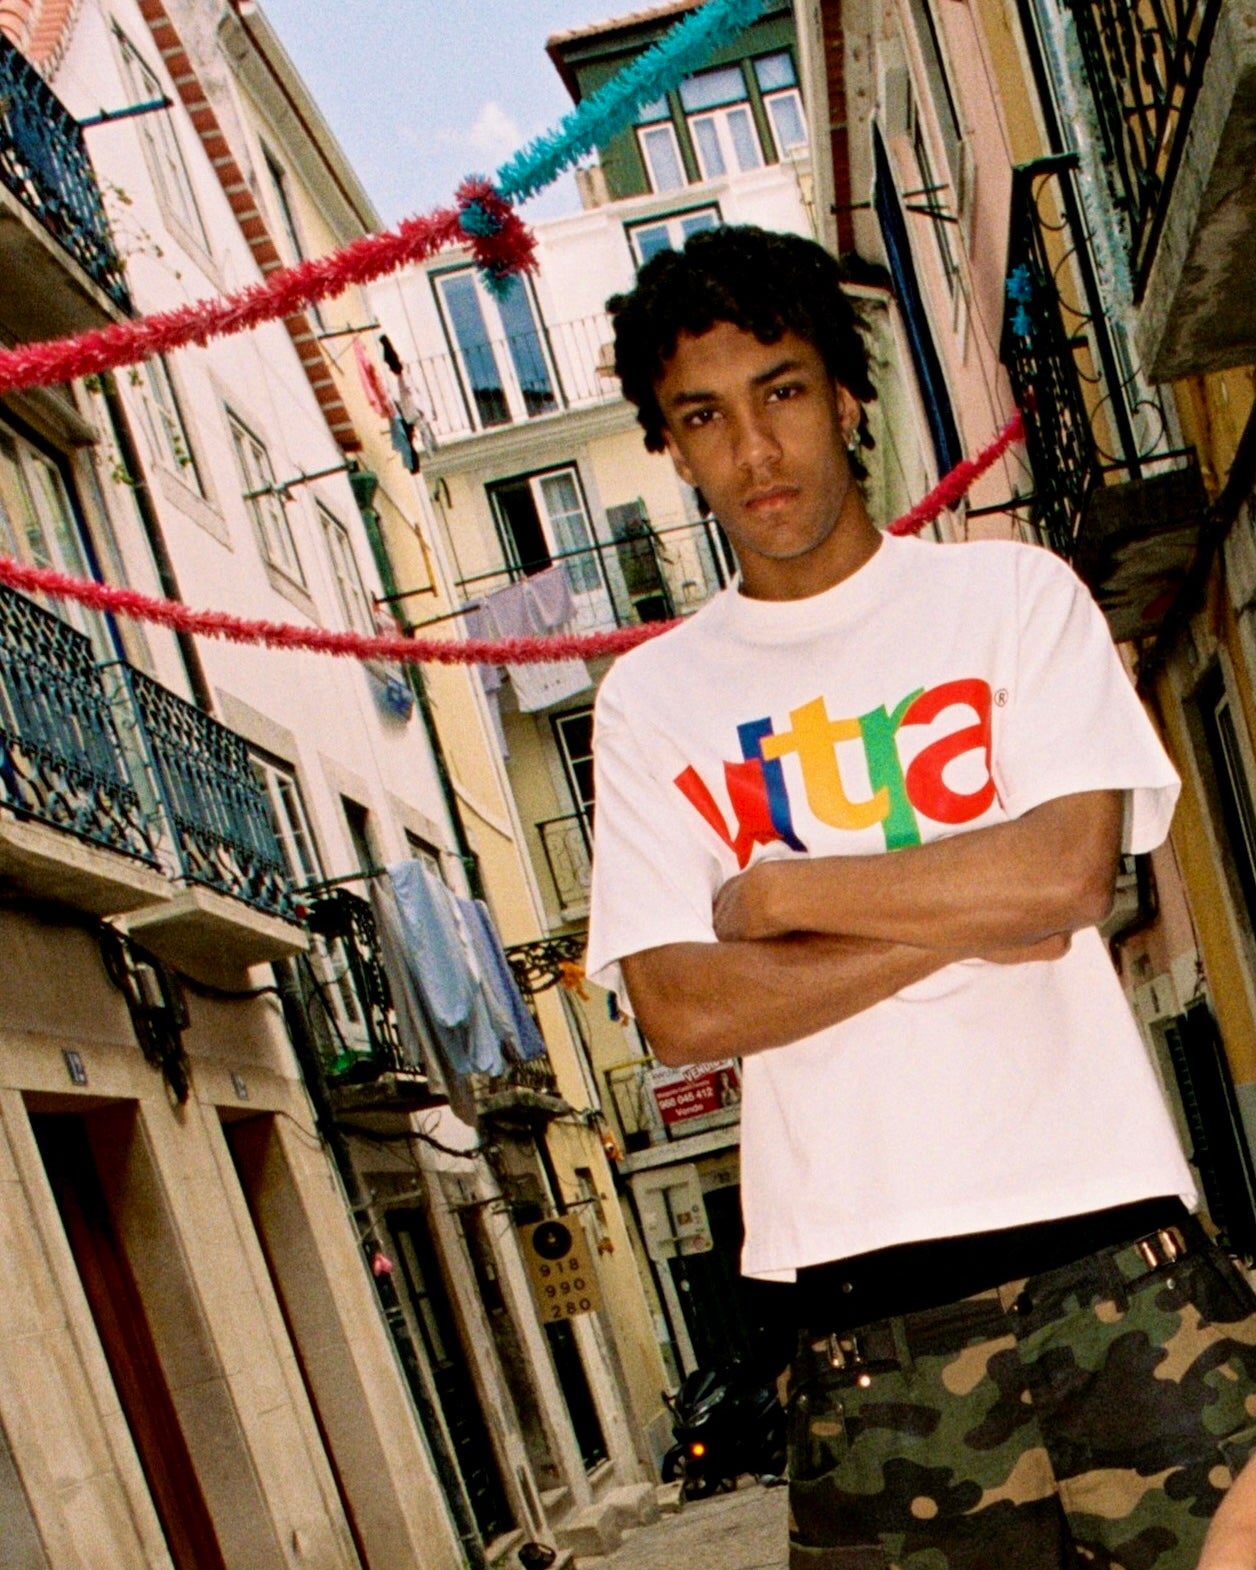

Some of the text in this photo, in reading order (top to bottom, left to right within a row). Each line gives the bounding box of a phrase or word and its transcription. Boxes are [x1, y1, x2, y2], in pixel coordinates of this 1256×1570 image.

[539, 1258, 580, 1277] 918
[545, 1278, 586, 1298] 990
[551, 1298, 591, 1318] 280
